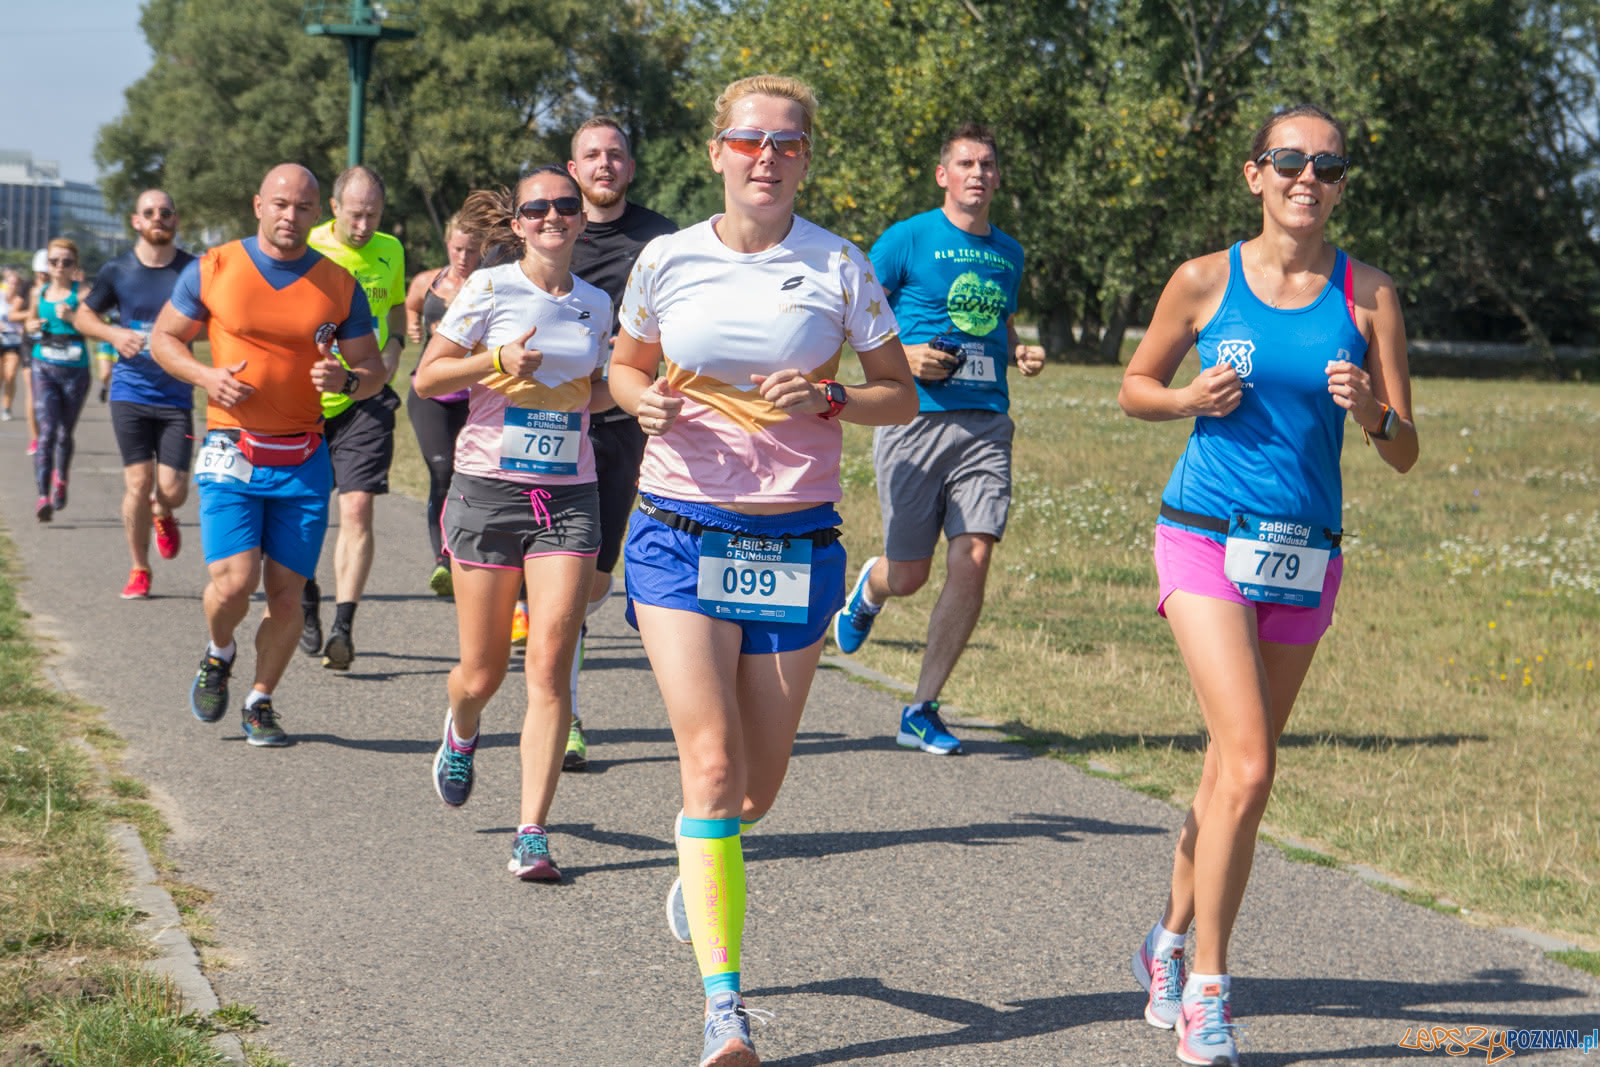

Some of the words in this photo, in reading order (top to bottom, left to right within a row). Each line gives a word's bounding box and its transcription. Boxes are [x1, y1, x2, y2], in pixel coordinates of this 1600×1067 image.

[934, 249, 955, 260] RLM
[524, 433, 565, 457] 767
[203, 452, 236, 470] 670
[1259, 521, 1311, 539] zaBIEGaj
[1267, 534, 1308, 546] FUNdusze
[735, 550, 782, 562] FUNdusze
[1254, 549, 1300, 580] 779
[723, 567, 776, 596] 099
